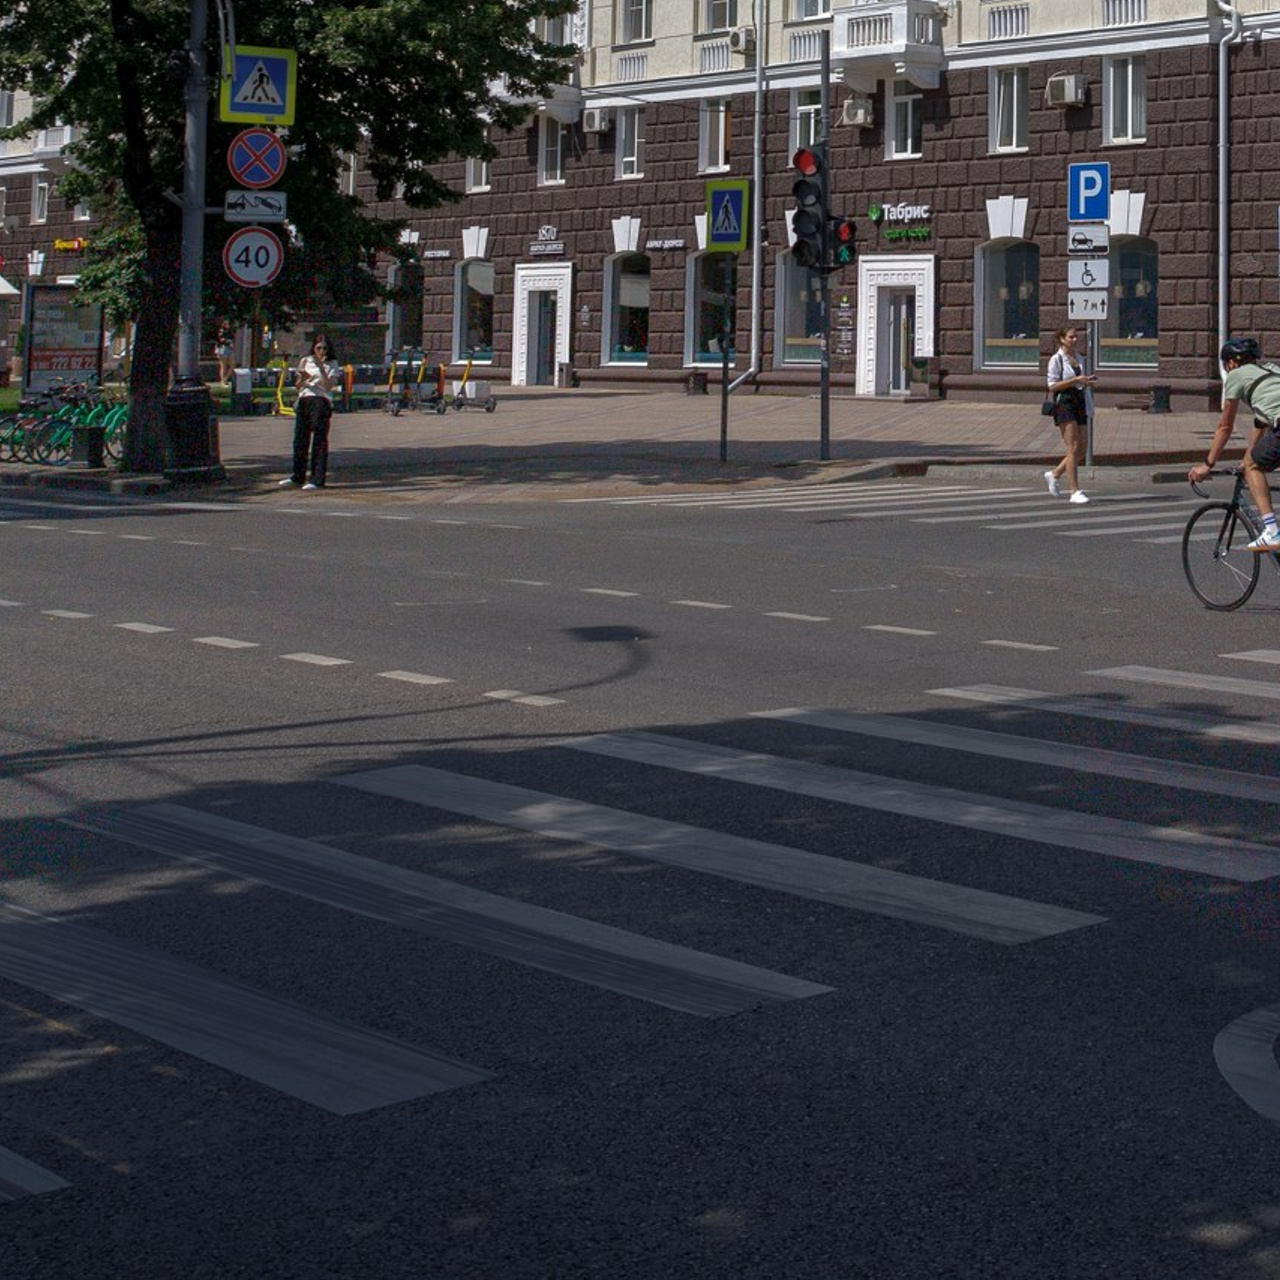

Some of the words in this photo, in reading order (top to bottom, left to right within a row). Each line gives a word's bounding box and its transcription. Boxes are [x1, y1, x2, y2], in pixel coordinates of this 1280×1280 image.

[1079, 170, 1102, 214] P
[882, 202, 930, 222] Табрис
[234, 245, 270, 269] 40
[1083, 299, 1089, 310] 7
